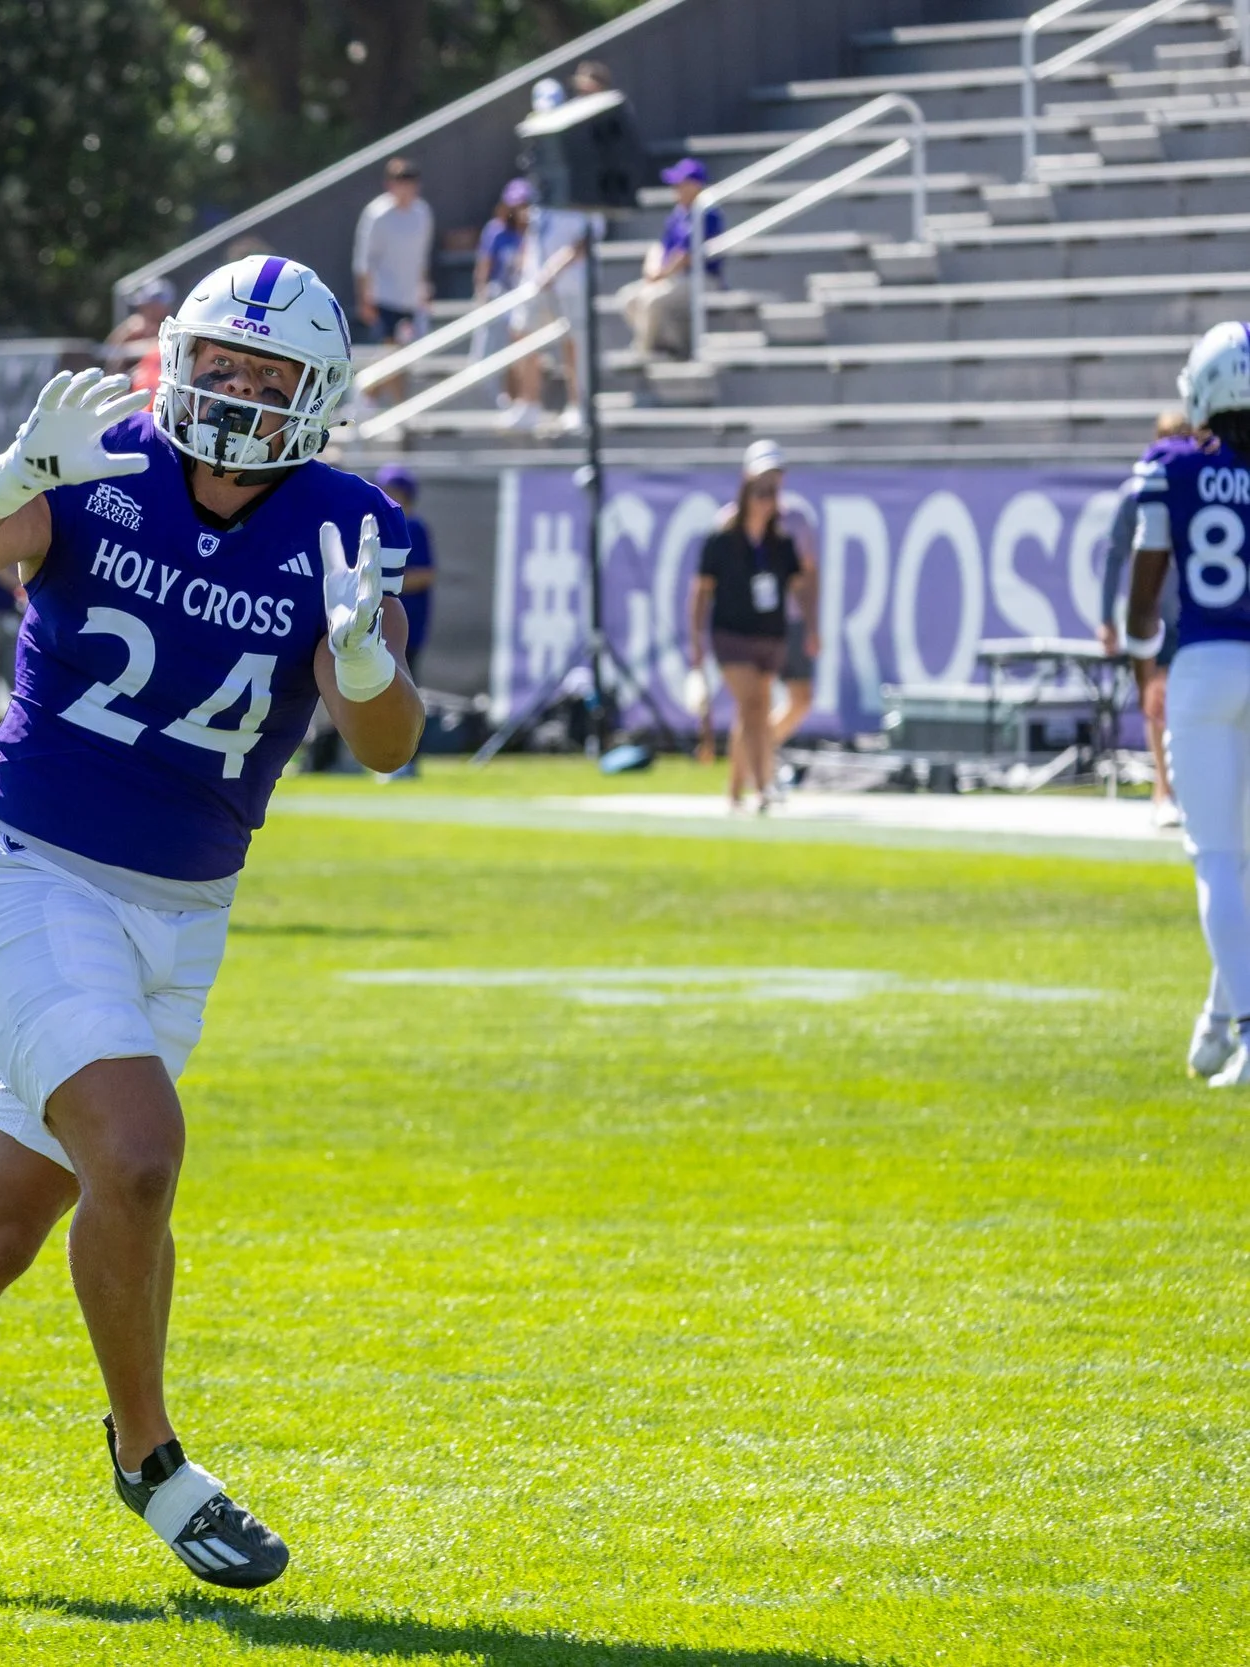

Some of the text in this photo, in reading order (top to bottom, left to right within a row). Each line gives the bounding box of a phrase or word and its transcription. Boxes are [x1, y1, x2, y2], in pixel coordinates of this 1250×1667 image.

[85, 502, 140, 532] LEAGUE
[87, 494, 144, 525] PATRIOT
[1198, 466, 1250, 504] GOR
[90, 538, 295, 637] HOLY CROSS
[1186, 504, 1250, 610] 8
[57, 606, 278, 779] 24
